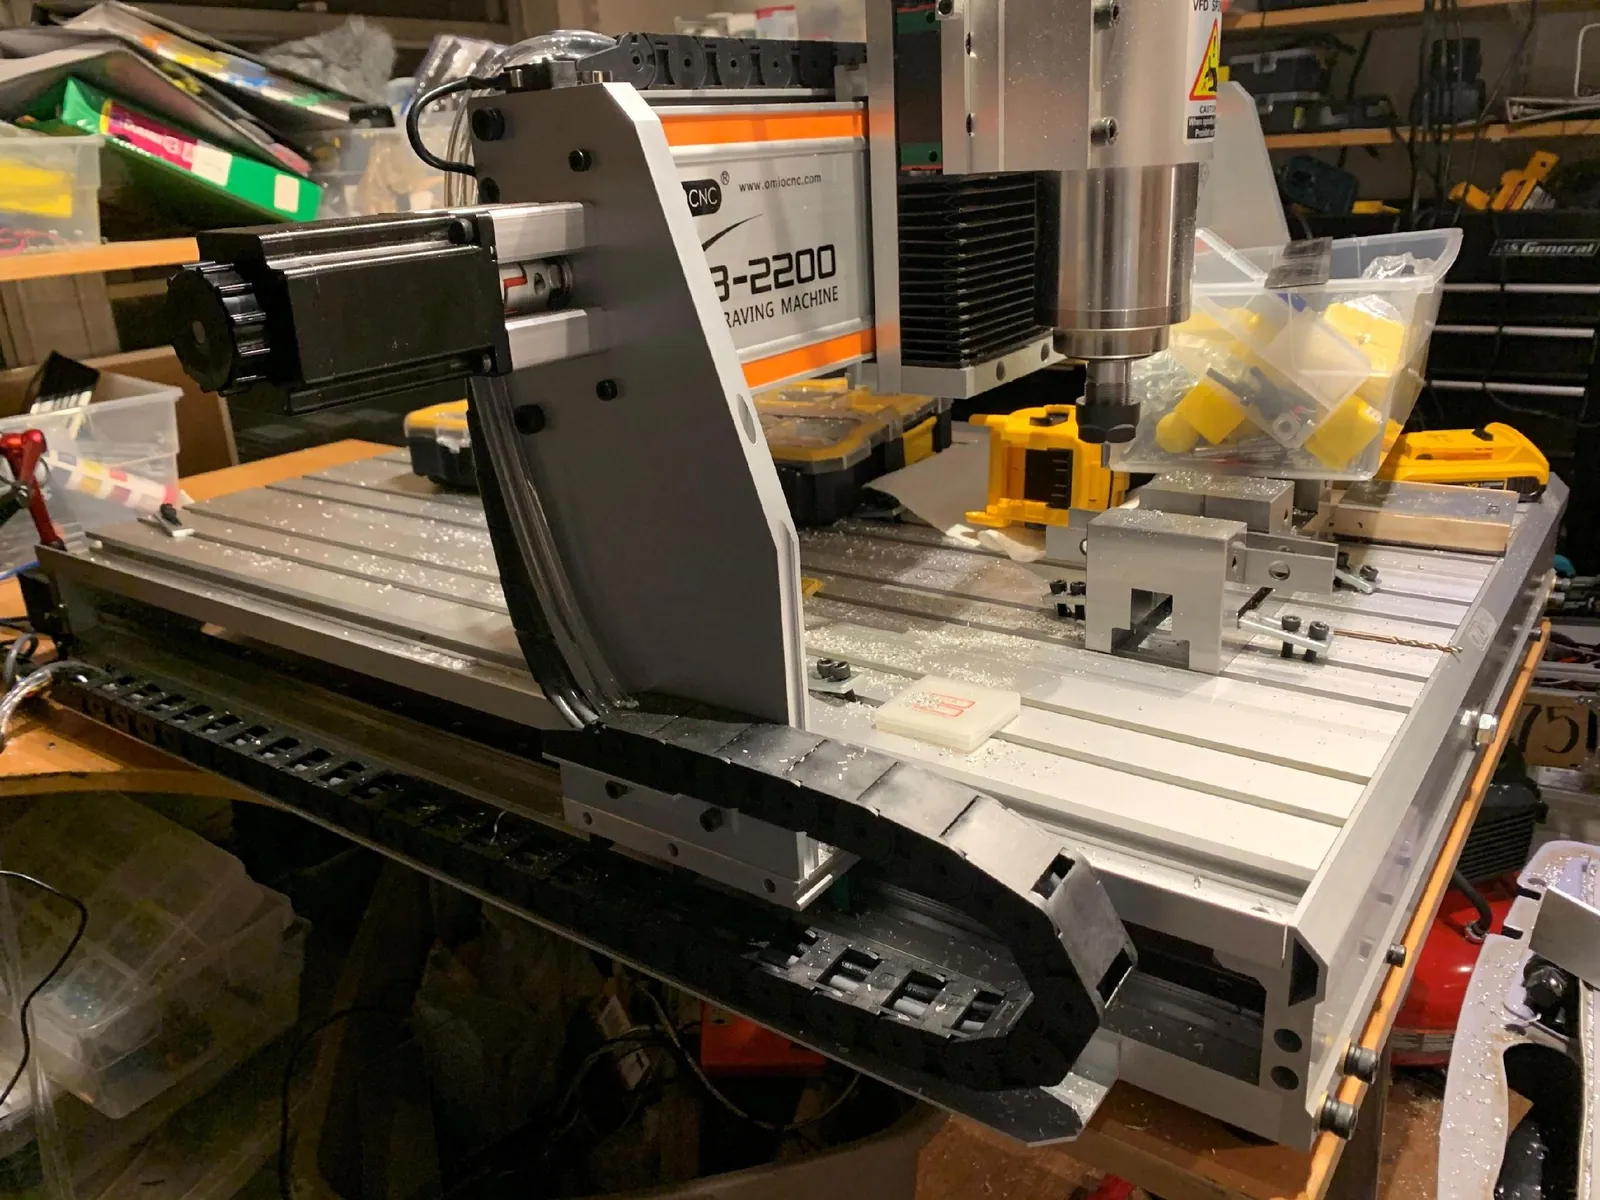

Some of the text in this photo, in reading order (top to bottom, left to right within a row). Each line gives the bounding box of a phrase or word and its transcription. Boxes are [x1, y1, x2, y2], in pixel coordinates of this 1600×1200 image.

[739, 174, 822, 192] www.omiocnc.com
[688, 186, 718, 208] CNC
[781, 285, 839, 315] MACHINE
